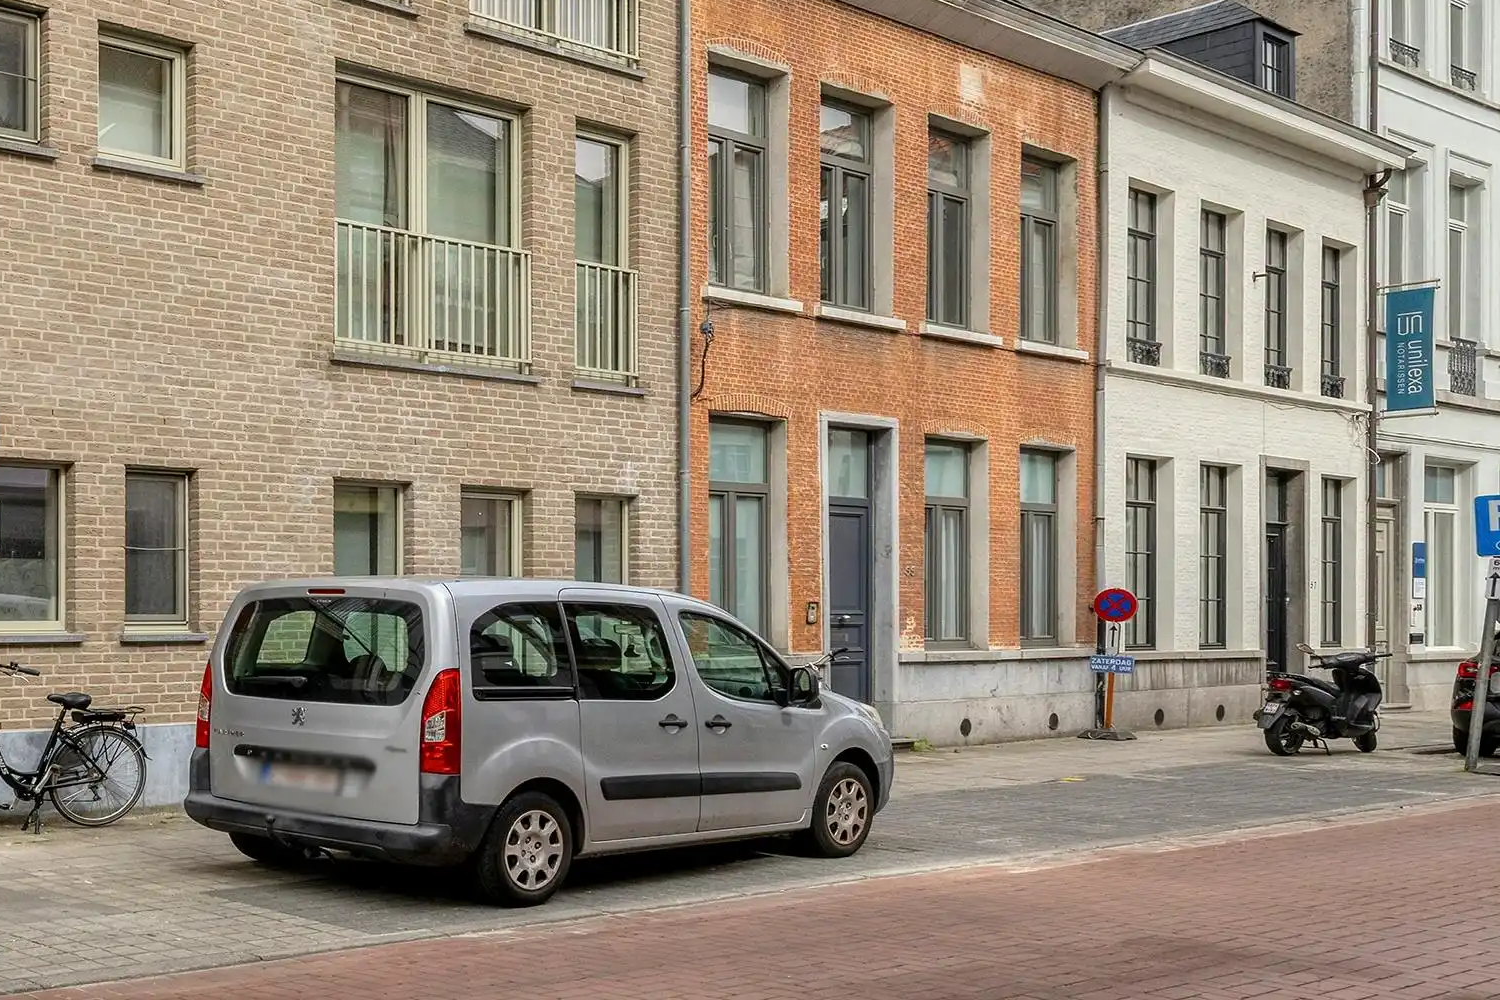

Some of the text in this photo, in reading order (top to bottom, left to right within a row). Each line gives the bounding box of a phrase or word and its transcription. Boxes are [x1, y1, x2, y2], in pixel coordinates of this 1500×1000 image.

[1397, 342, 1406, 394] NOTARISSEN
[1407, 340, 1428, 395] unilexa
[1091, 657, 1132, 666] ZATERDAG
